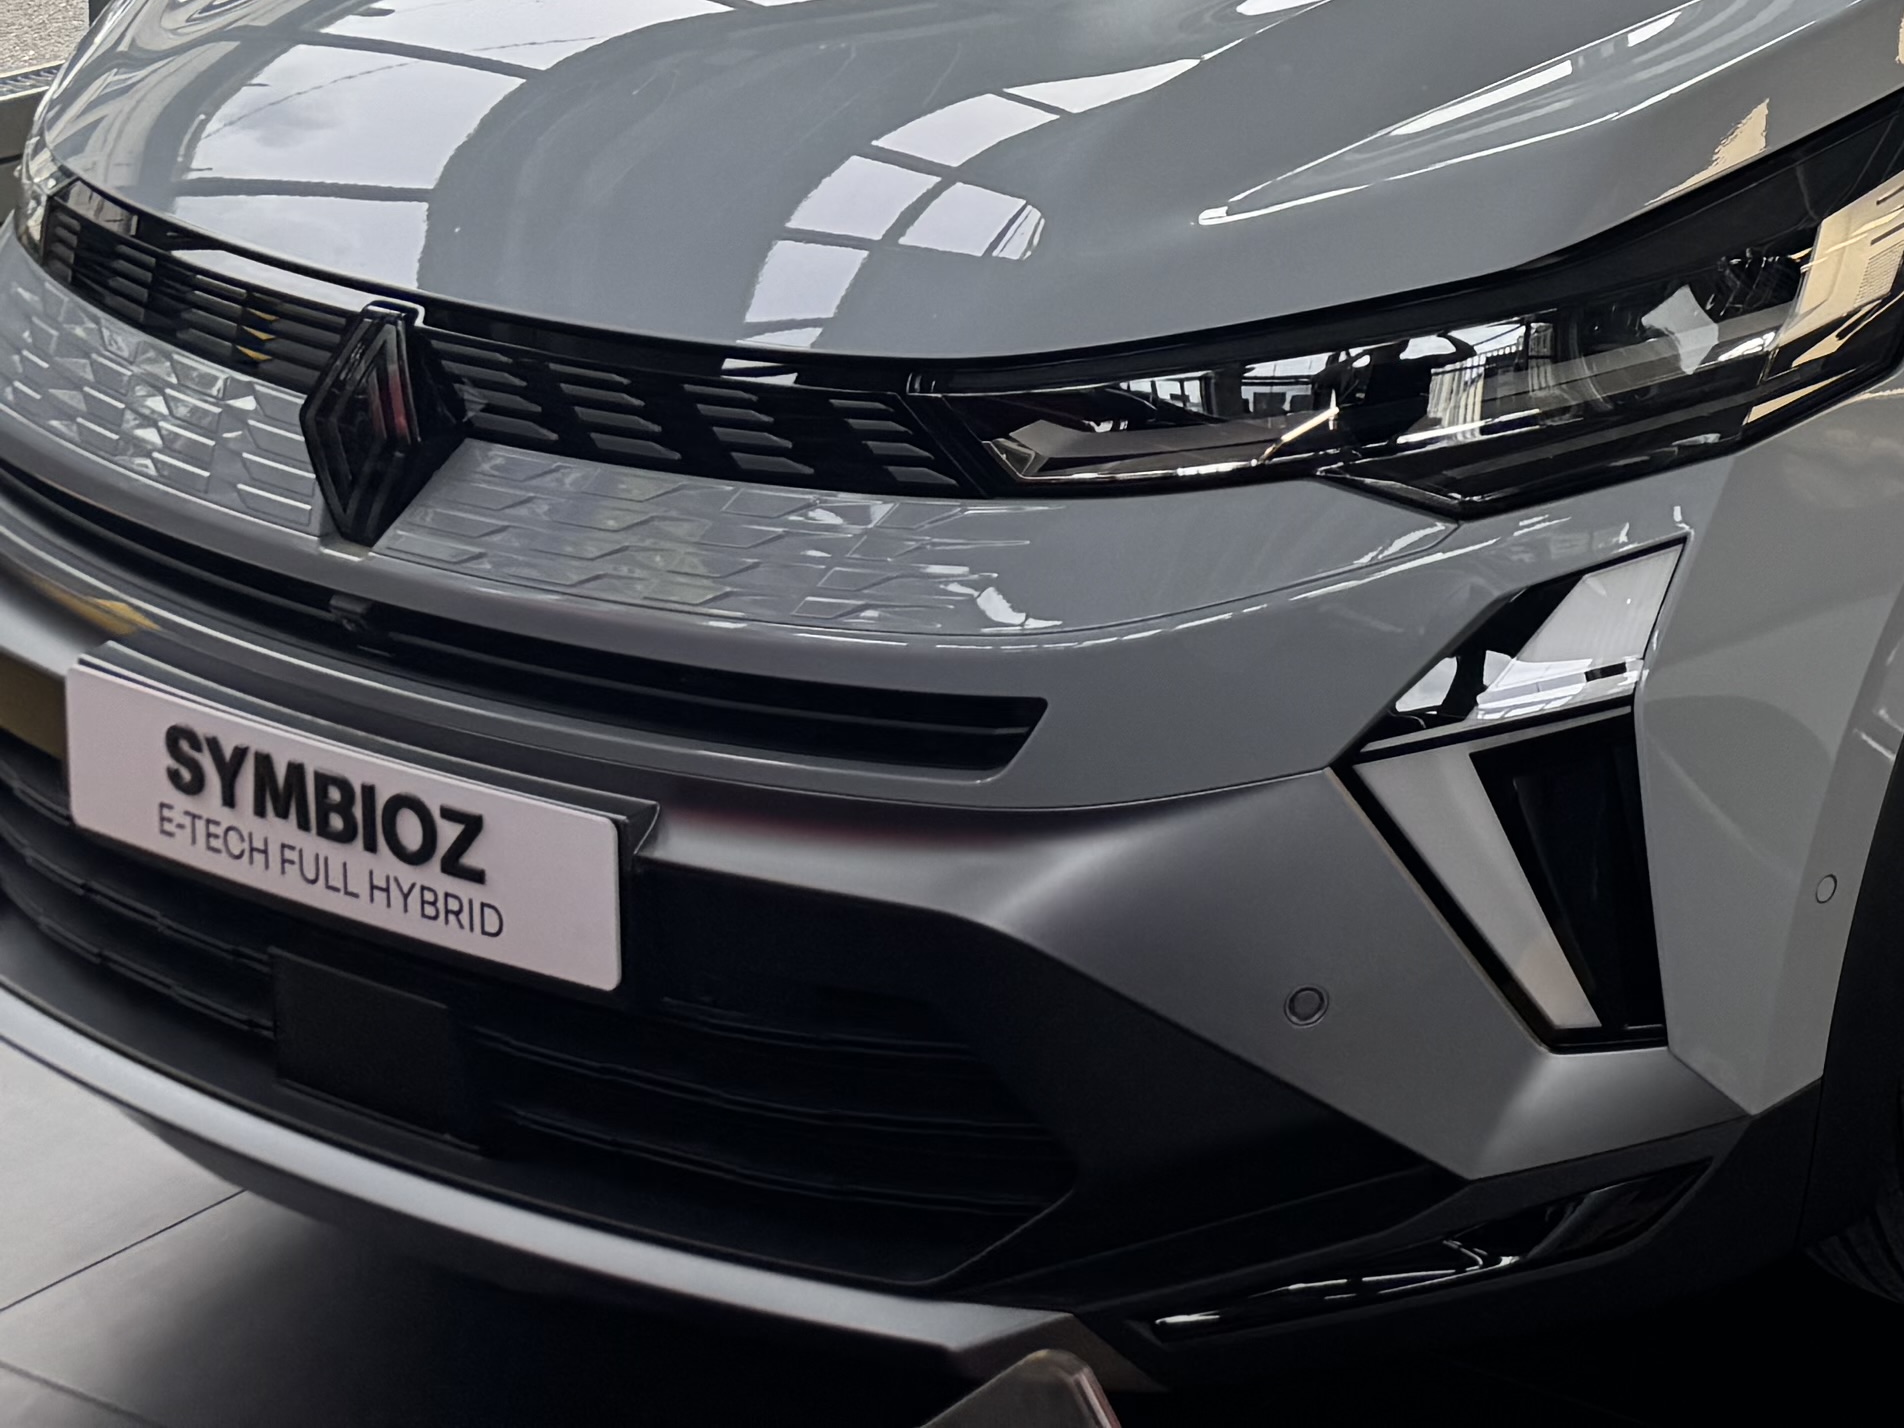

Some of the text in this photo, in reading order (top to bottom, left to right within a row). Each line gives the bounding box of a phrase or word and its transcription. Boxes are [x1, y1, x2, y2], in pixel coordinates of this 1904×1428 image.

[157, 801, 504, 940] E-TECH FULL HYBRID
[163, 722, 487, 886] SYMBIOZ
